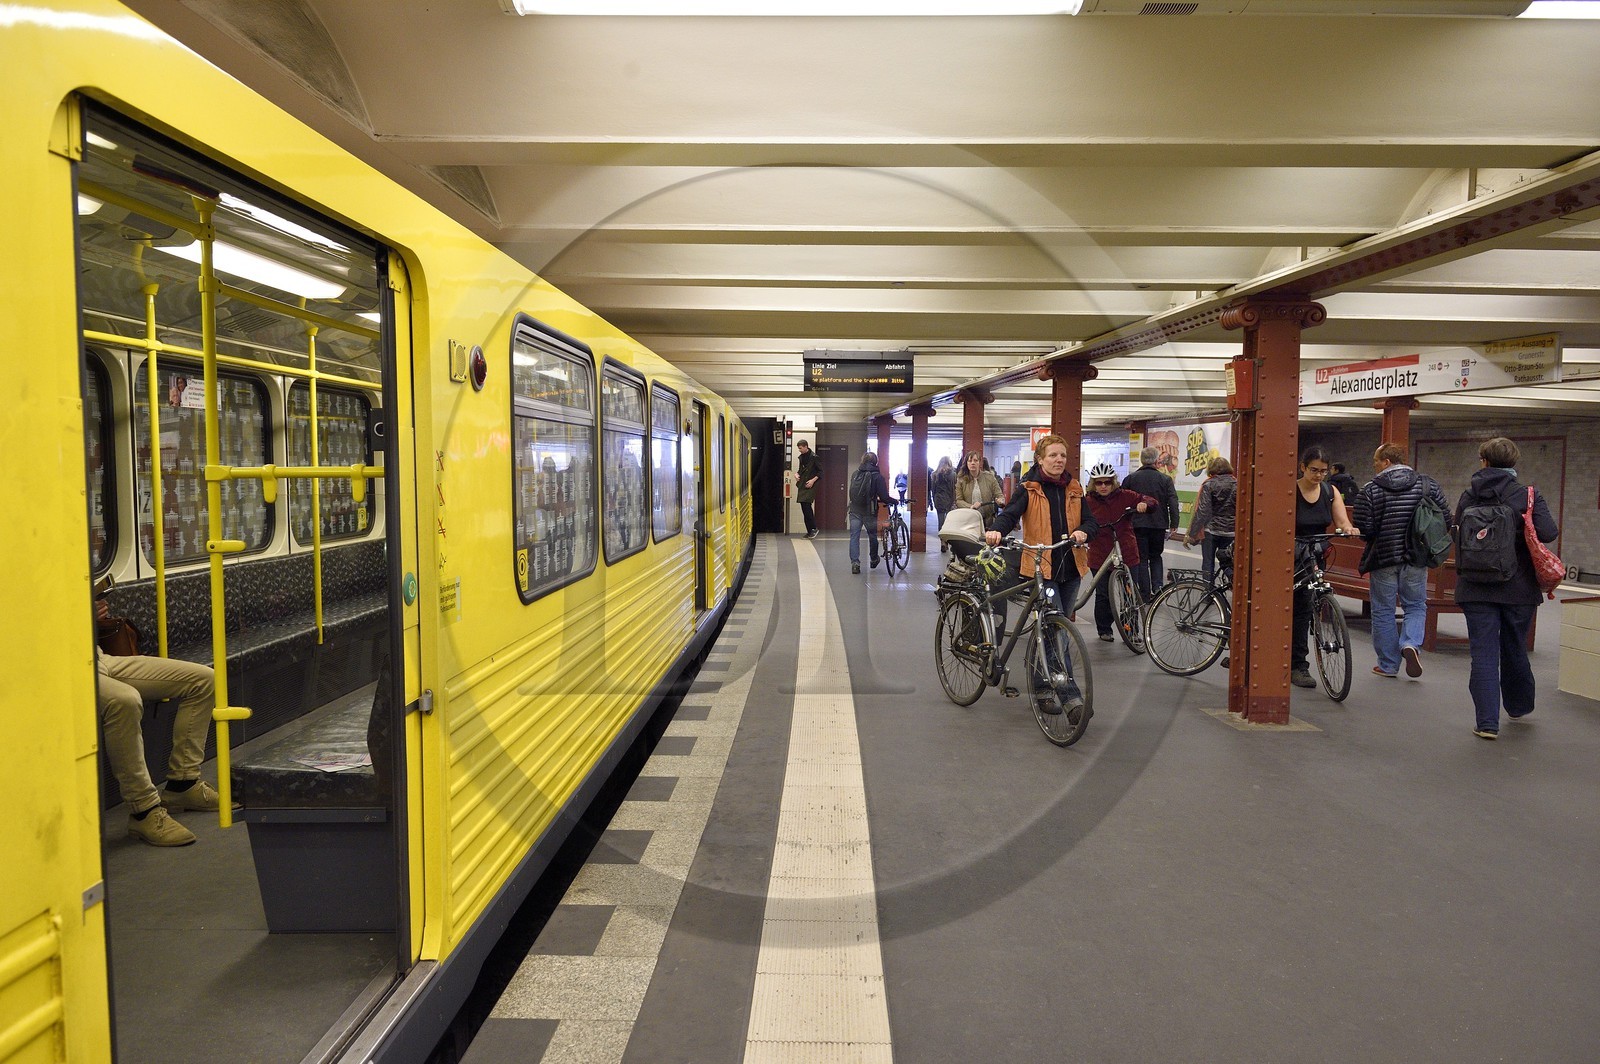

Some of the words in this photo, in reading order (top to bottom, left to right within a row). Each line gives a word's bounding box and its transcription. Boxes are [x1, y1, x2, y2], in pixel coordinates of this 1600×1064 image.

[1521, 339, 1546, 348] Ausgang
[1316, 369, 1328, 382] U2
[1330, 368, 1419, 395] Alexanderplatz
[776, 432, 782, 442] E
[1187, 430, 1204, 451] SUB
[1190, 447, 1200, 458] DES
[1185, 451, 1209, 477] TAGES
